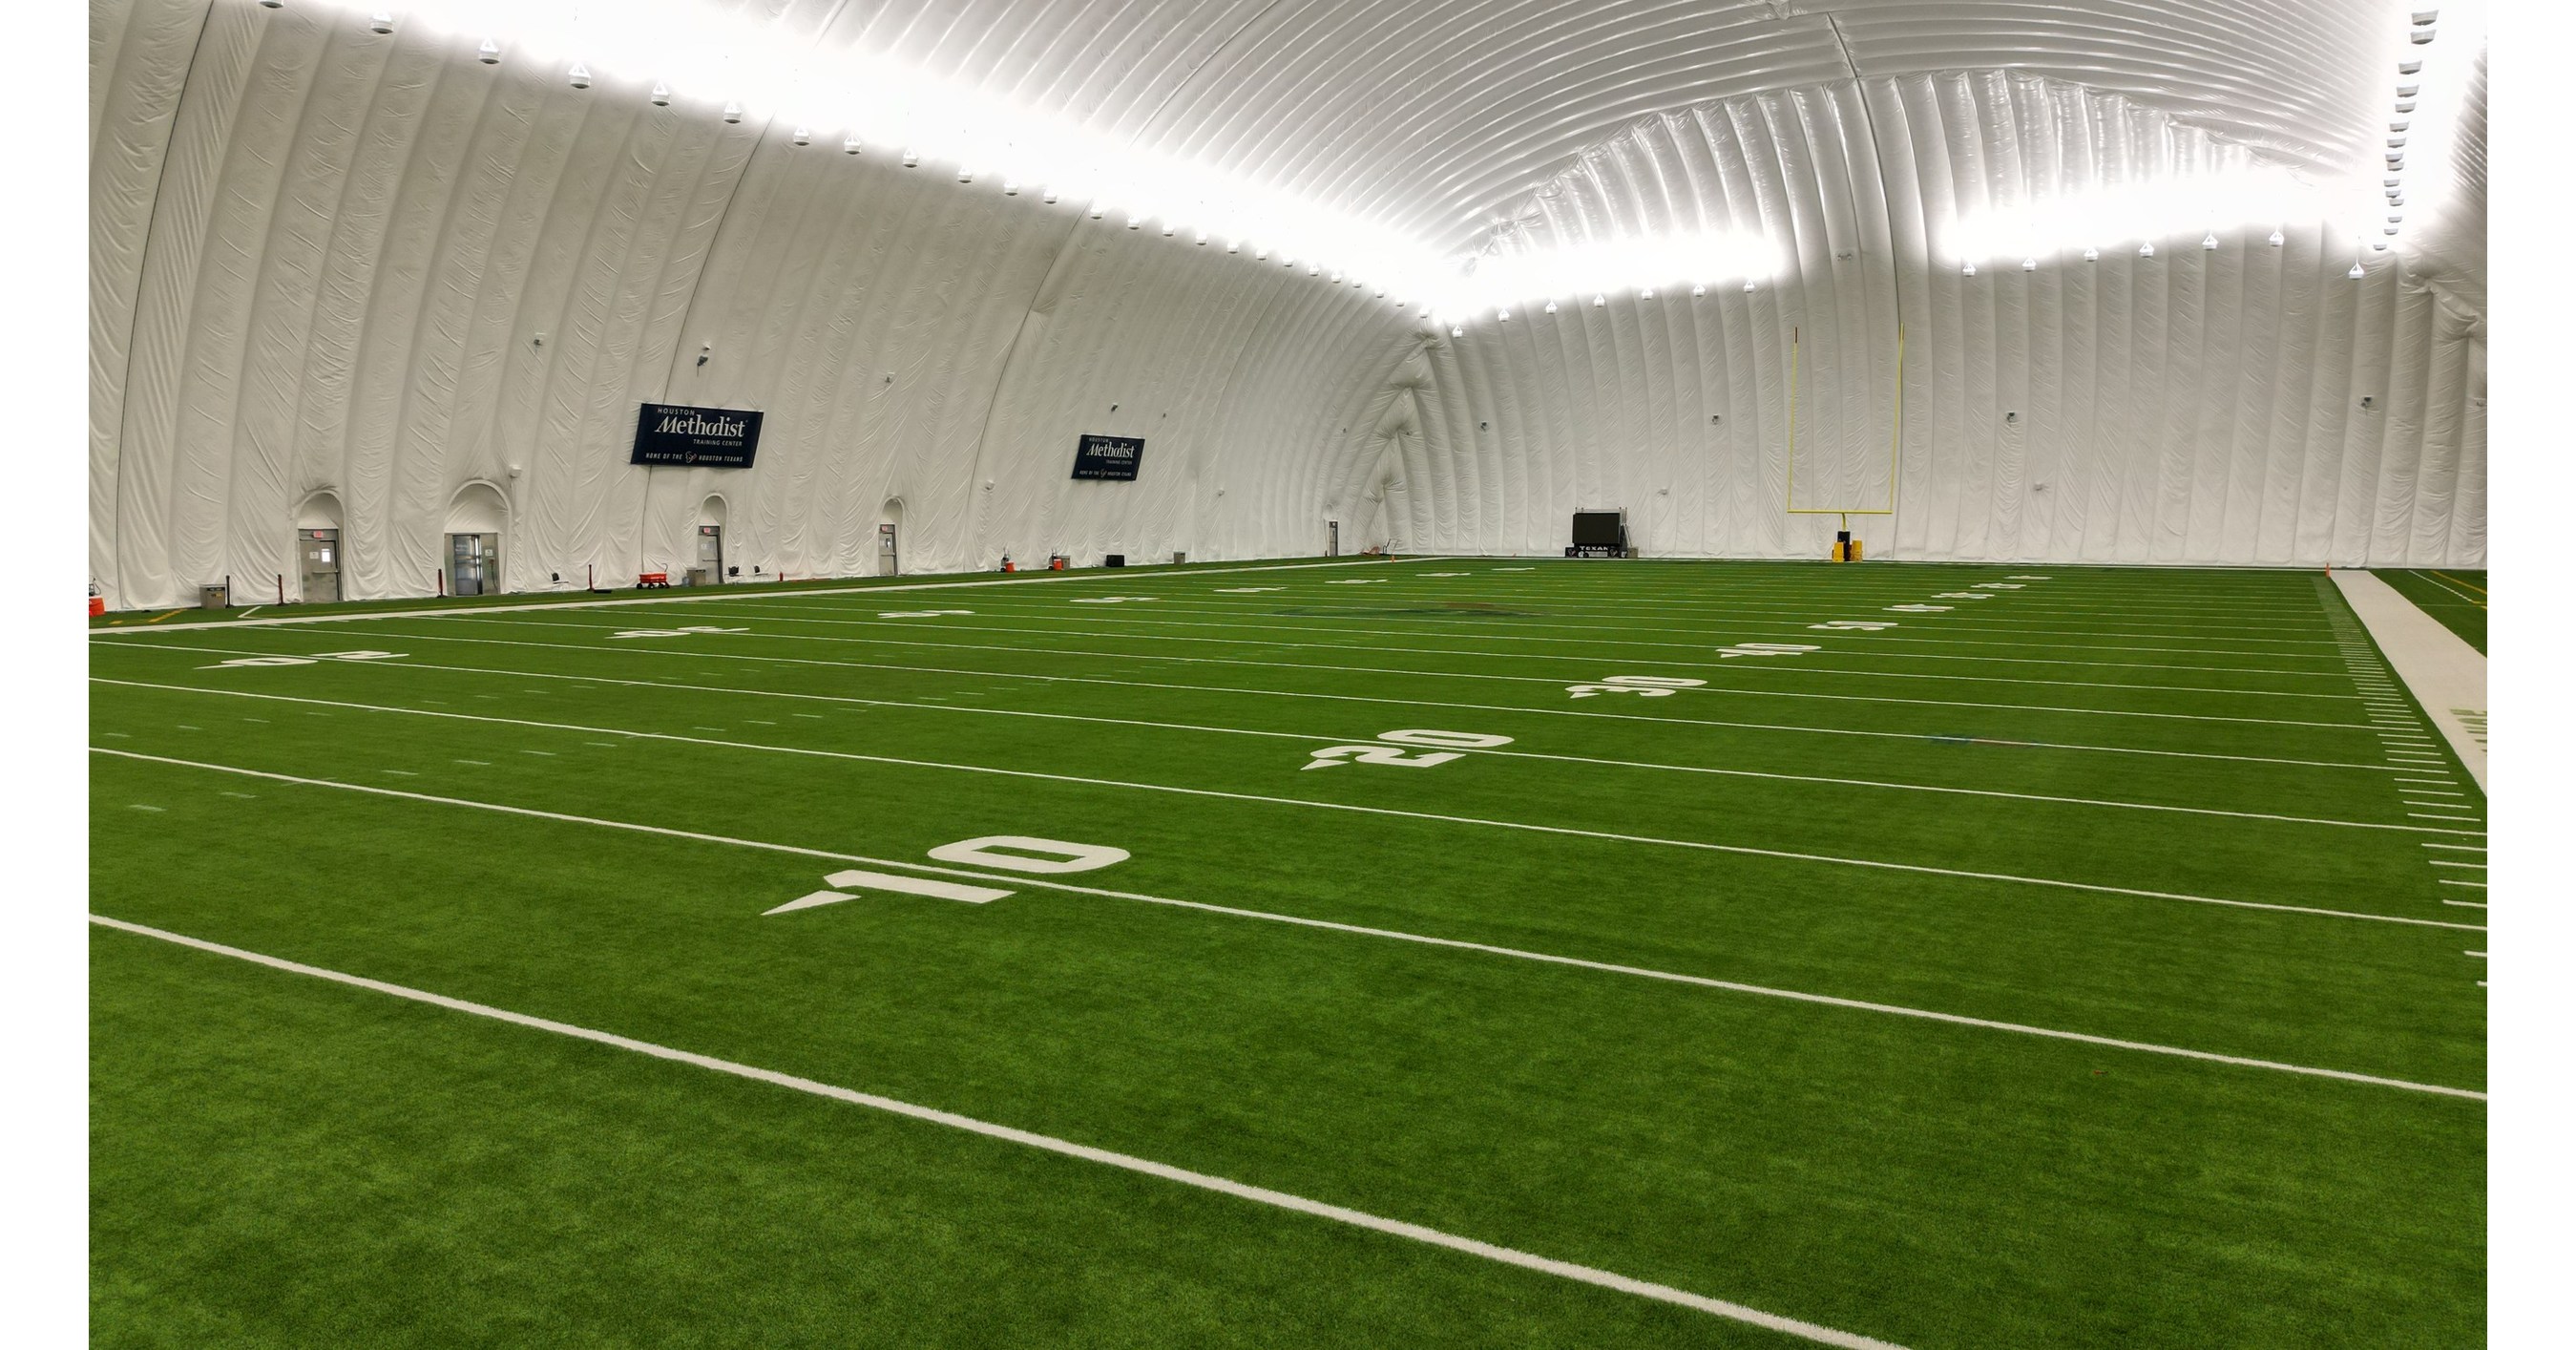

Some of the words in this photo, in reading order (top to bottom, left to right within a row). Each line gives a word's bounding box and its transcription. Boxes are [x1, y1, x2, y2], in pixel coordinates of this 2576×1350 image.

[658, 408, 695, 416] HOUSTON
[654, 414, 745, 437] Methodist
[1086, 441, 1135, 458] Methodist
[1565, 676, 1707, 697] 30
[1310, 729, 1515, 768] 20
[824, 835, 1130, 903] 10
